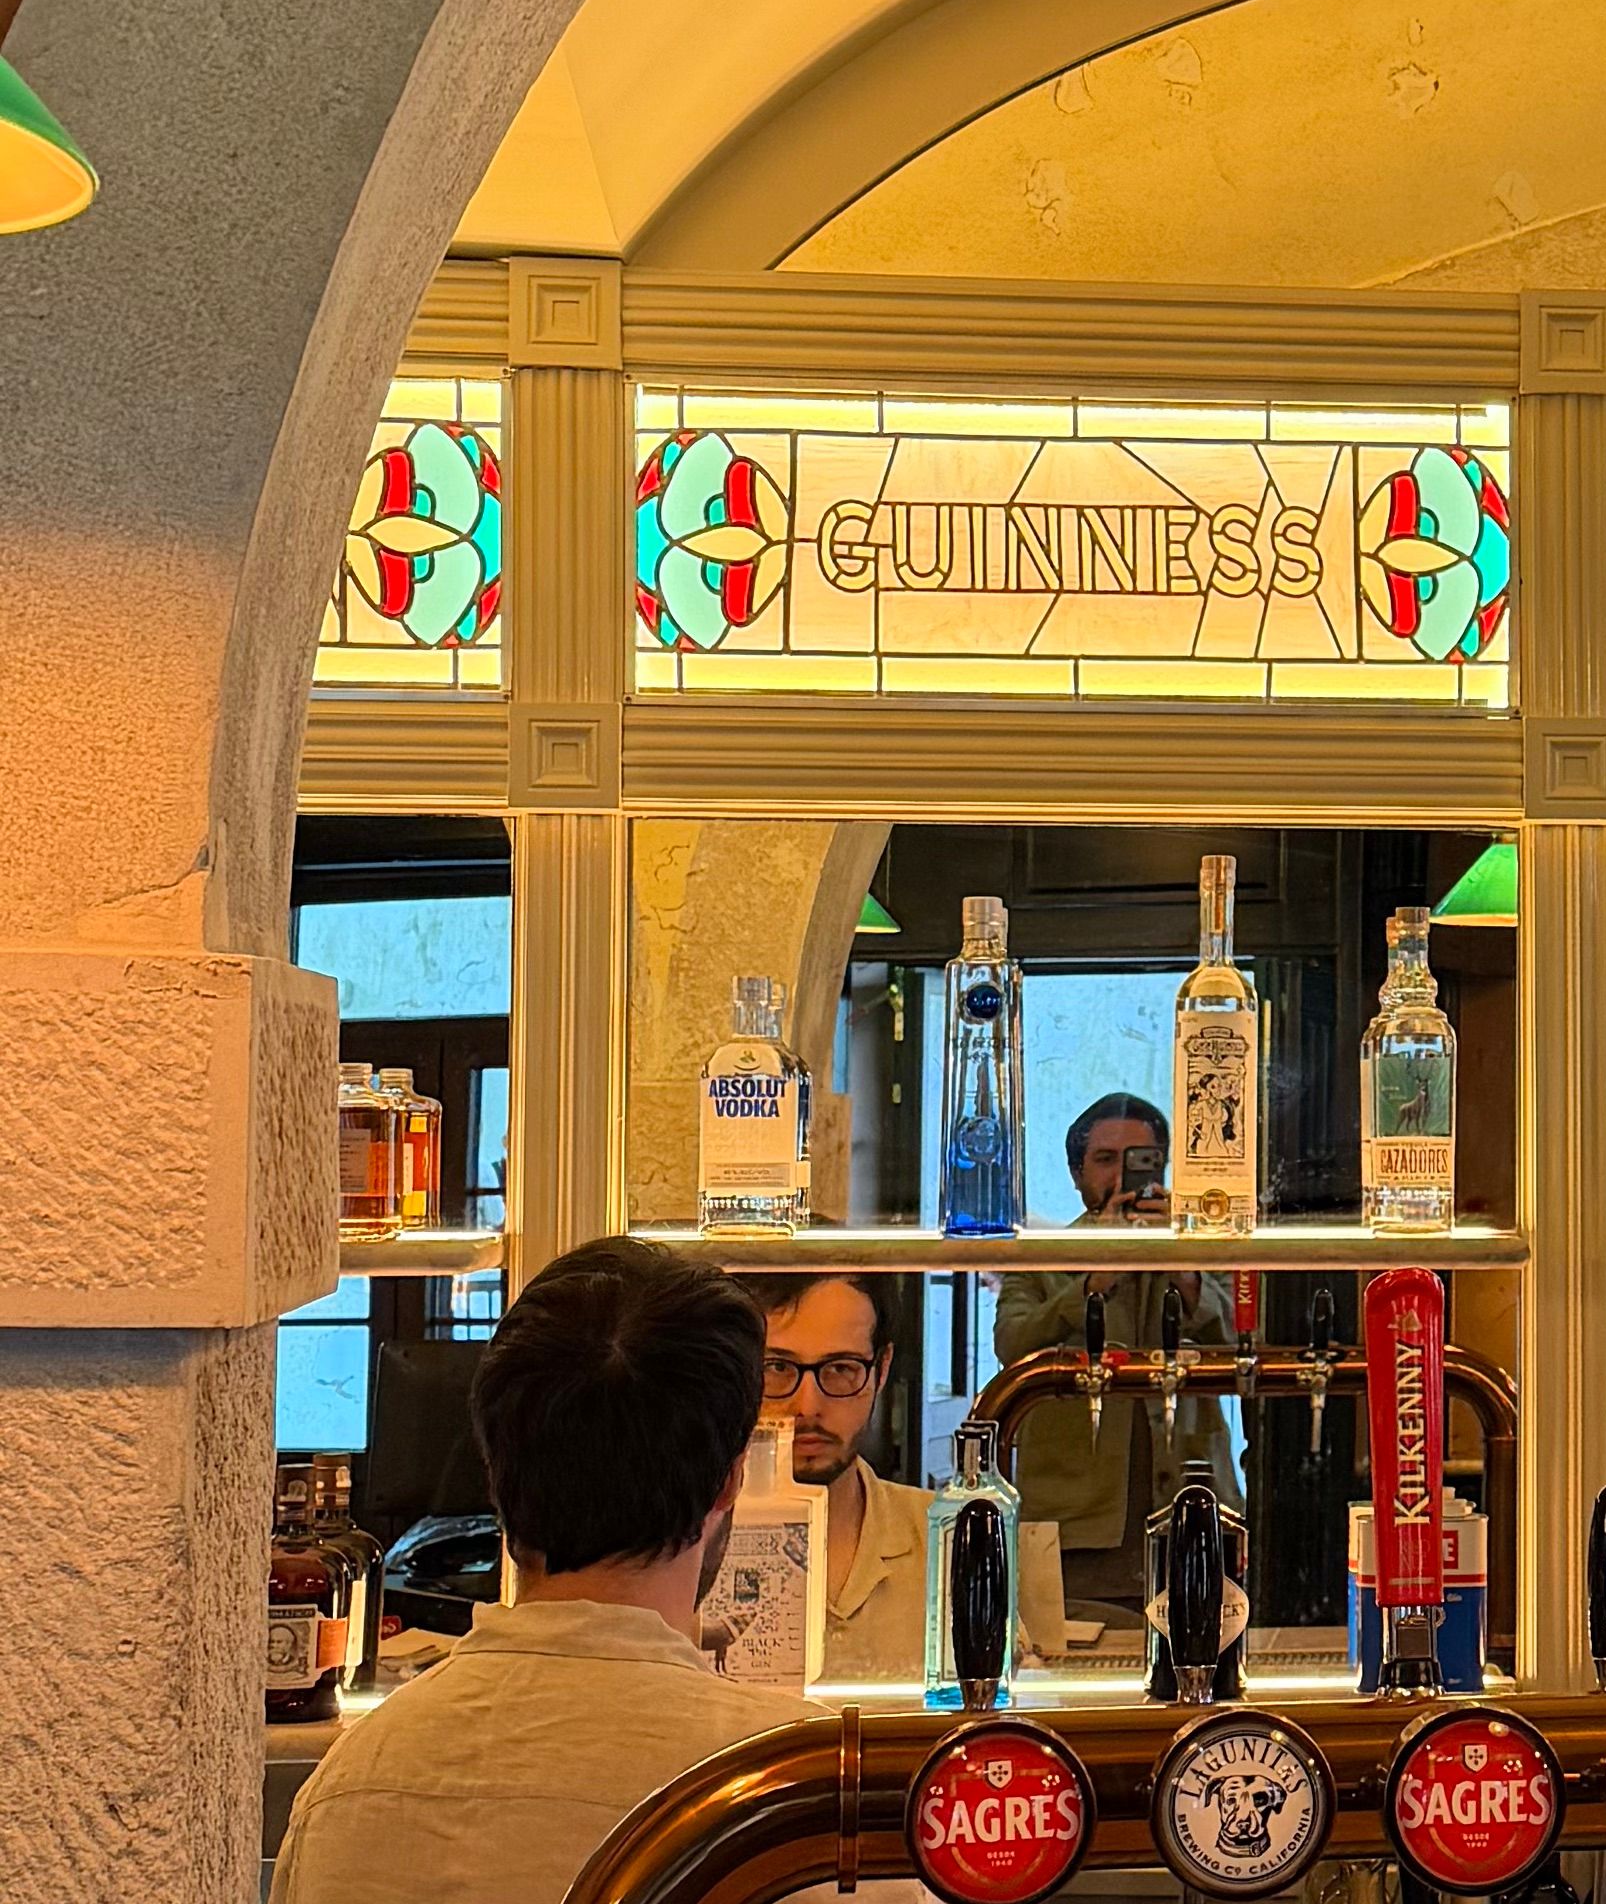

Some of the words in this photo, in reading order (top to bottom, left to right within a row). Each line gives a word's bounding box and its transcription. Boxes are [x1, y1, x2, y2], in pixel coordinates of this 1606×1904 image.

[817, 498, 1325, 598] GUINNESS
[709, 1079, 787, 1098] ABSOLUT
[715, 1099, 780, 1118] VODKA
[1380, 1148, 1449, 1174] CAZADORES
[1393, 1340, 1431, 1526] KILKENNY
[1179, 1737, 1309, 1799] LAGUNITAS
[922, 1788, 1080, 1850] SAGRES
[1402, 1774, 1550, 1829] SAGRES
[1178, 1813, 1220, 1870] BREWING
[1249, 1807, 1311, 1875] CALIFORNIA
